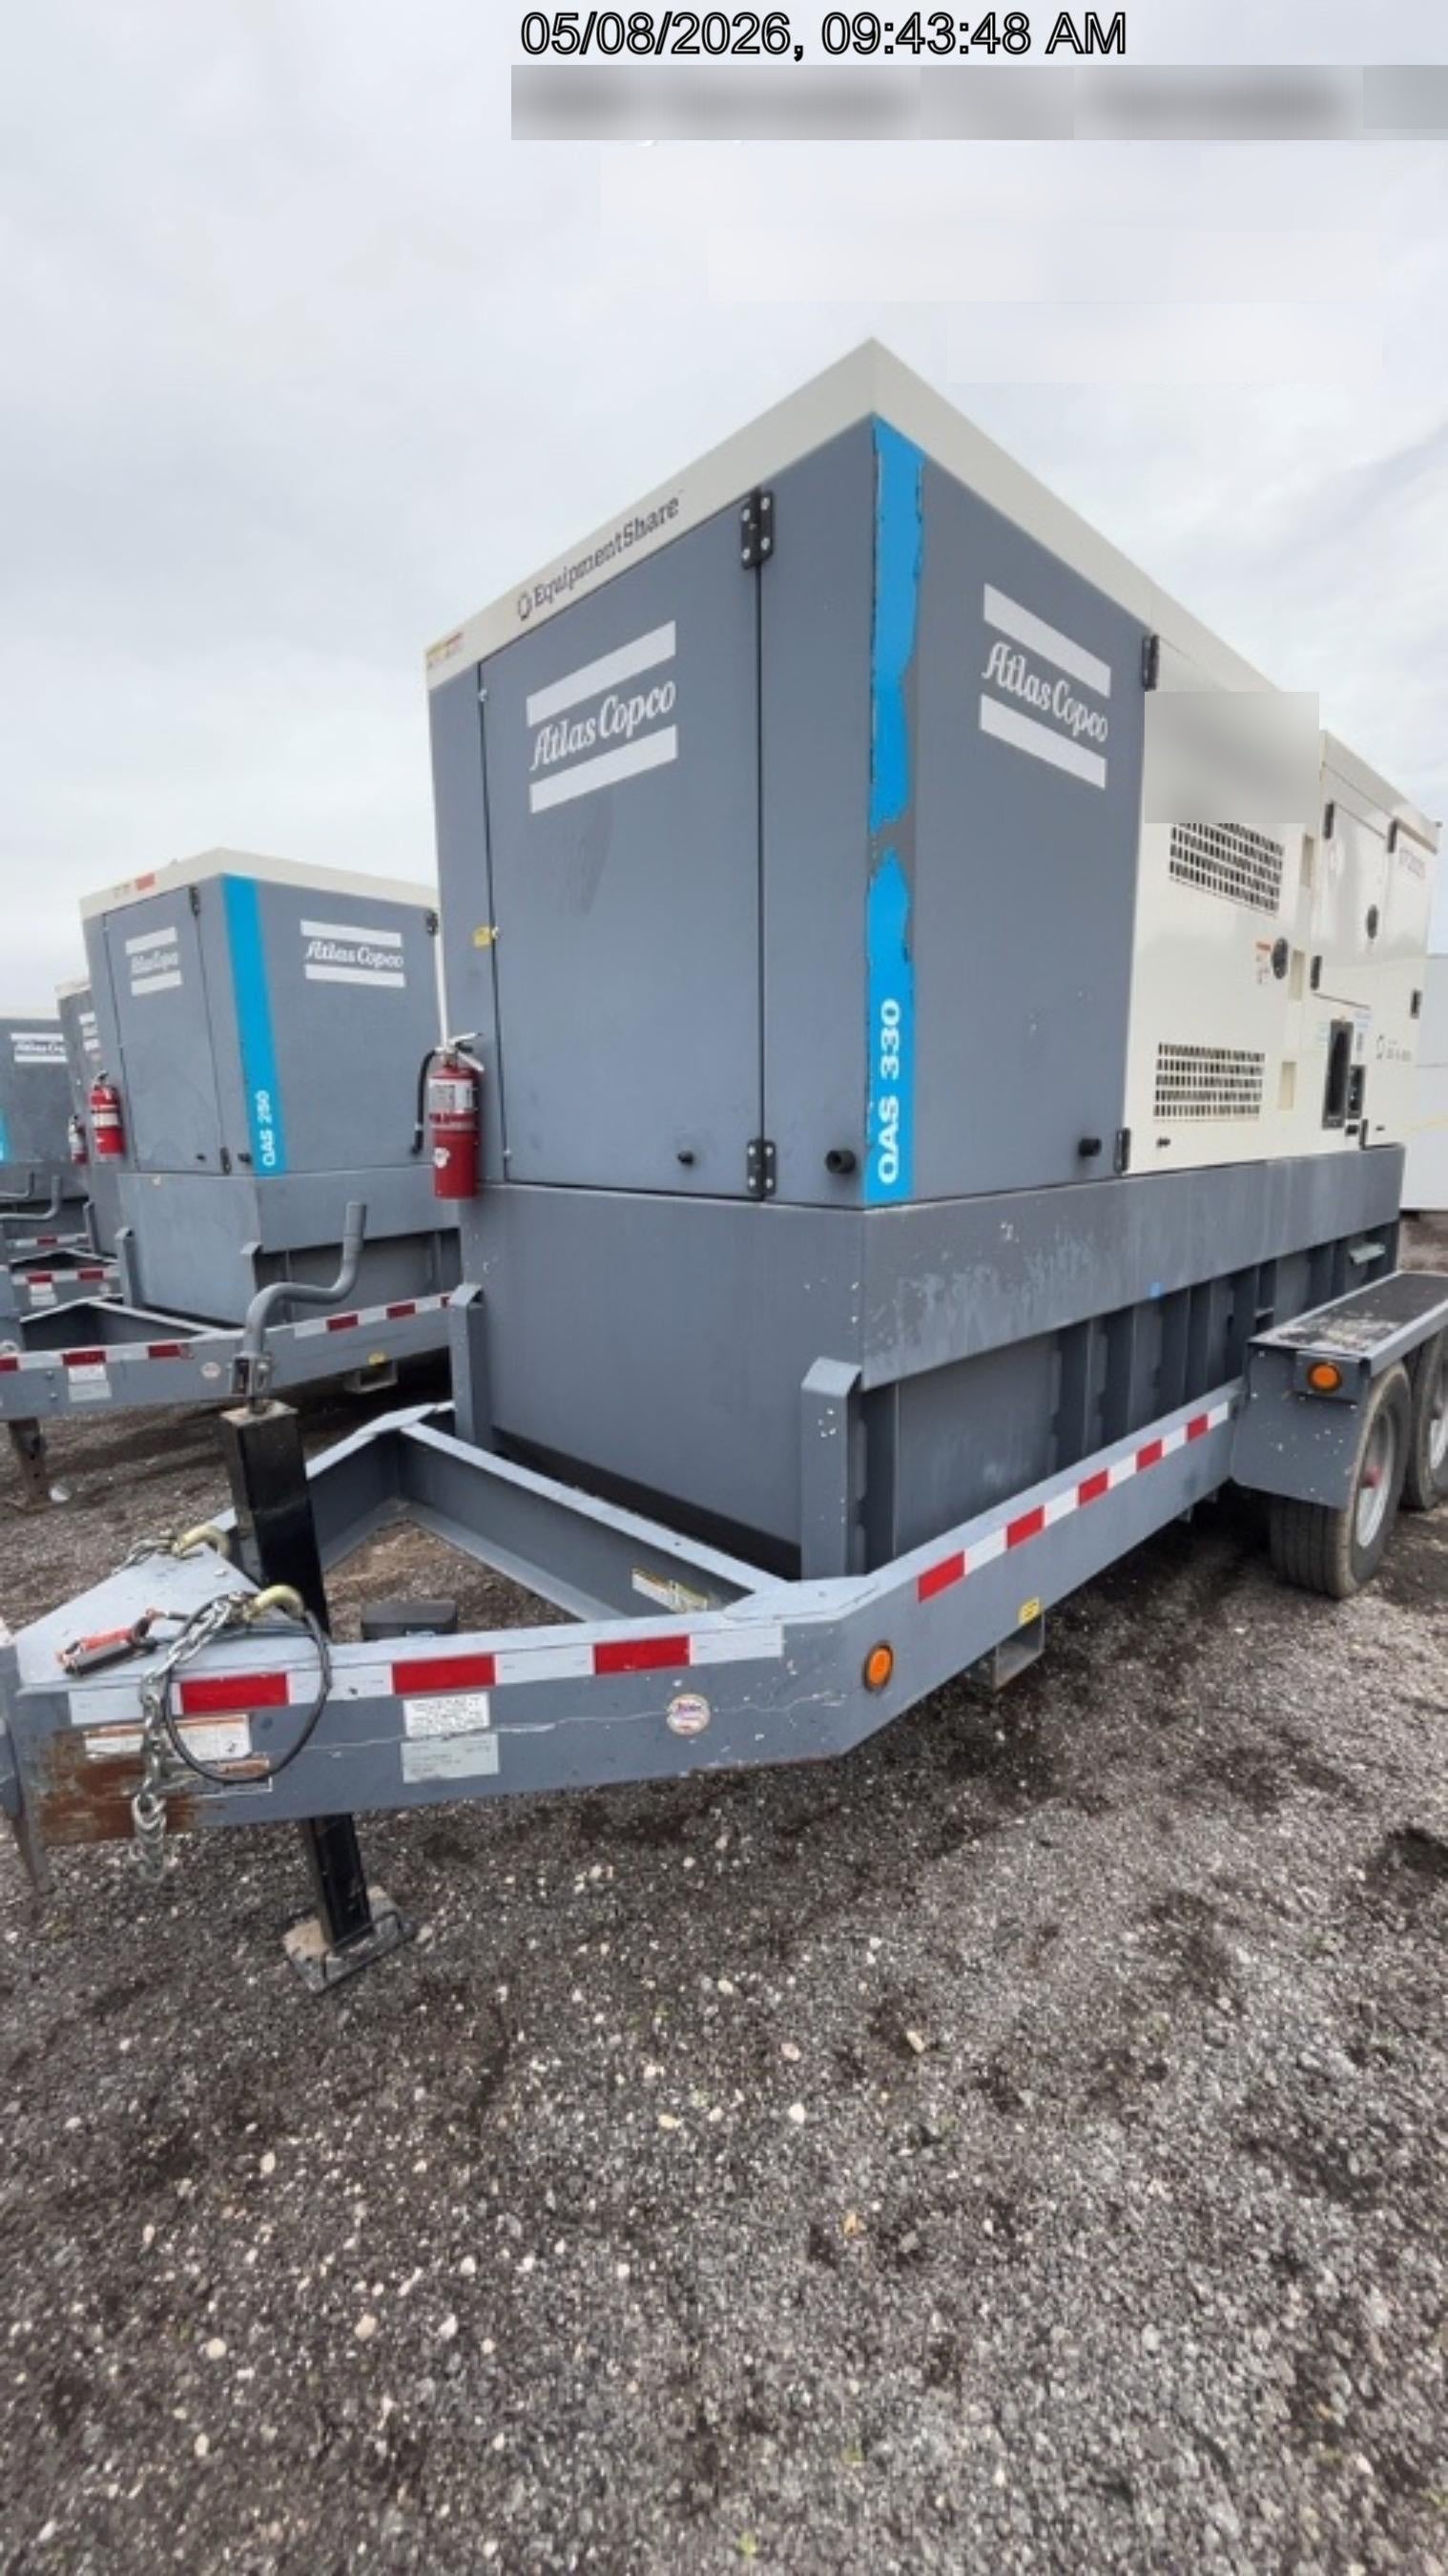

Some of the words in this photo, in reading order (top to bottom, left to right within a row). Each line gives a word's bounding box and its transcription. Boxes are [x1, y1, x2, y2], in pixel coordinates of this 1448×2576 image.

[533, 496, 680, 608] EquipmentShare
[529, 717, 597, 772] Atlas
[599, 680, 676, 739] Copco
[981, 640, 1051, 712] Atlas
[1052, 678, 1108, 742] Copco
[305, 939, 357, 964] Atlas
[357, 945, 404, 969] Copco
[880, 998, 900, 1081] 330
[878, 1094, 900, 1185] QAS
